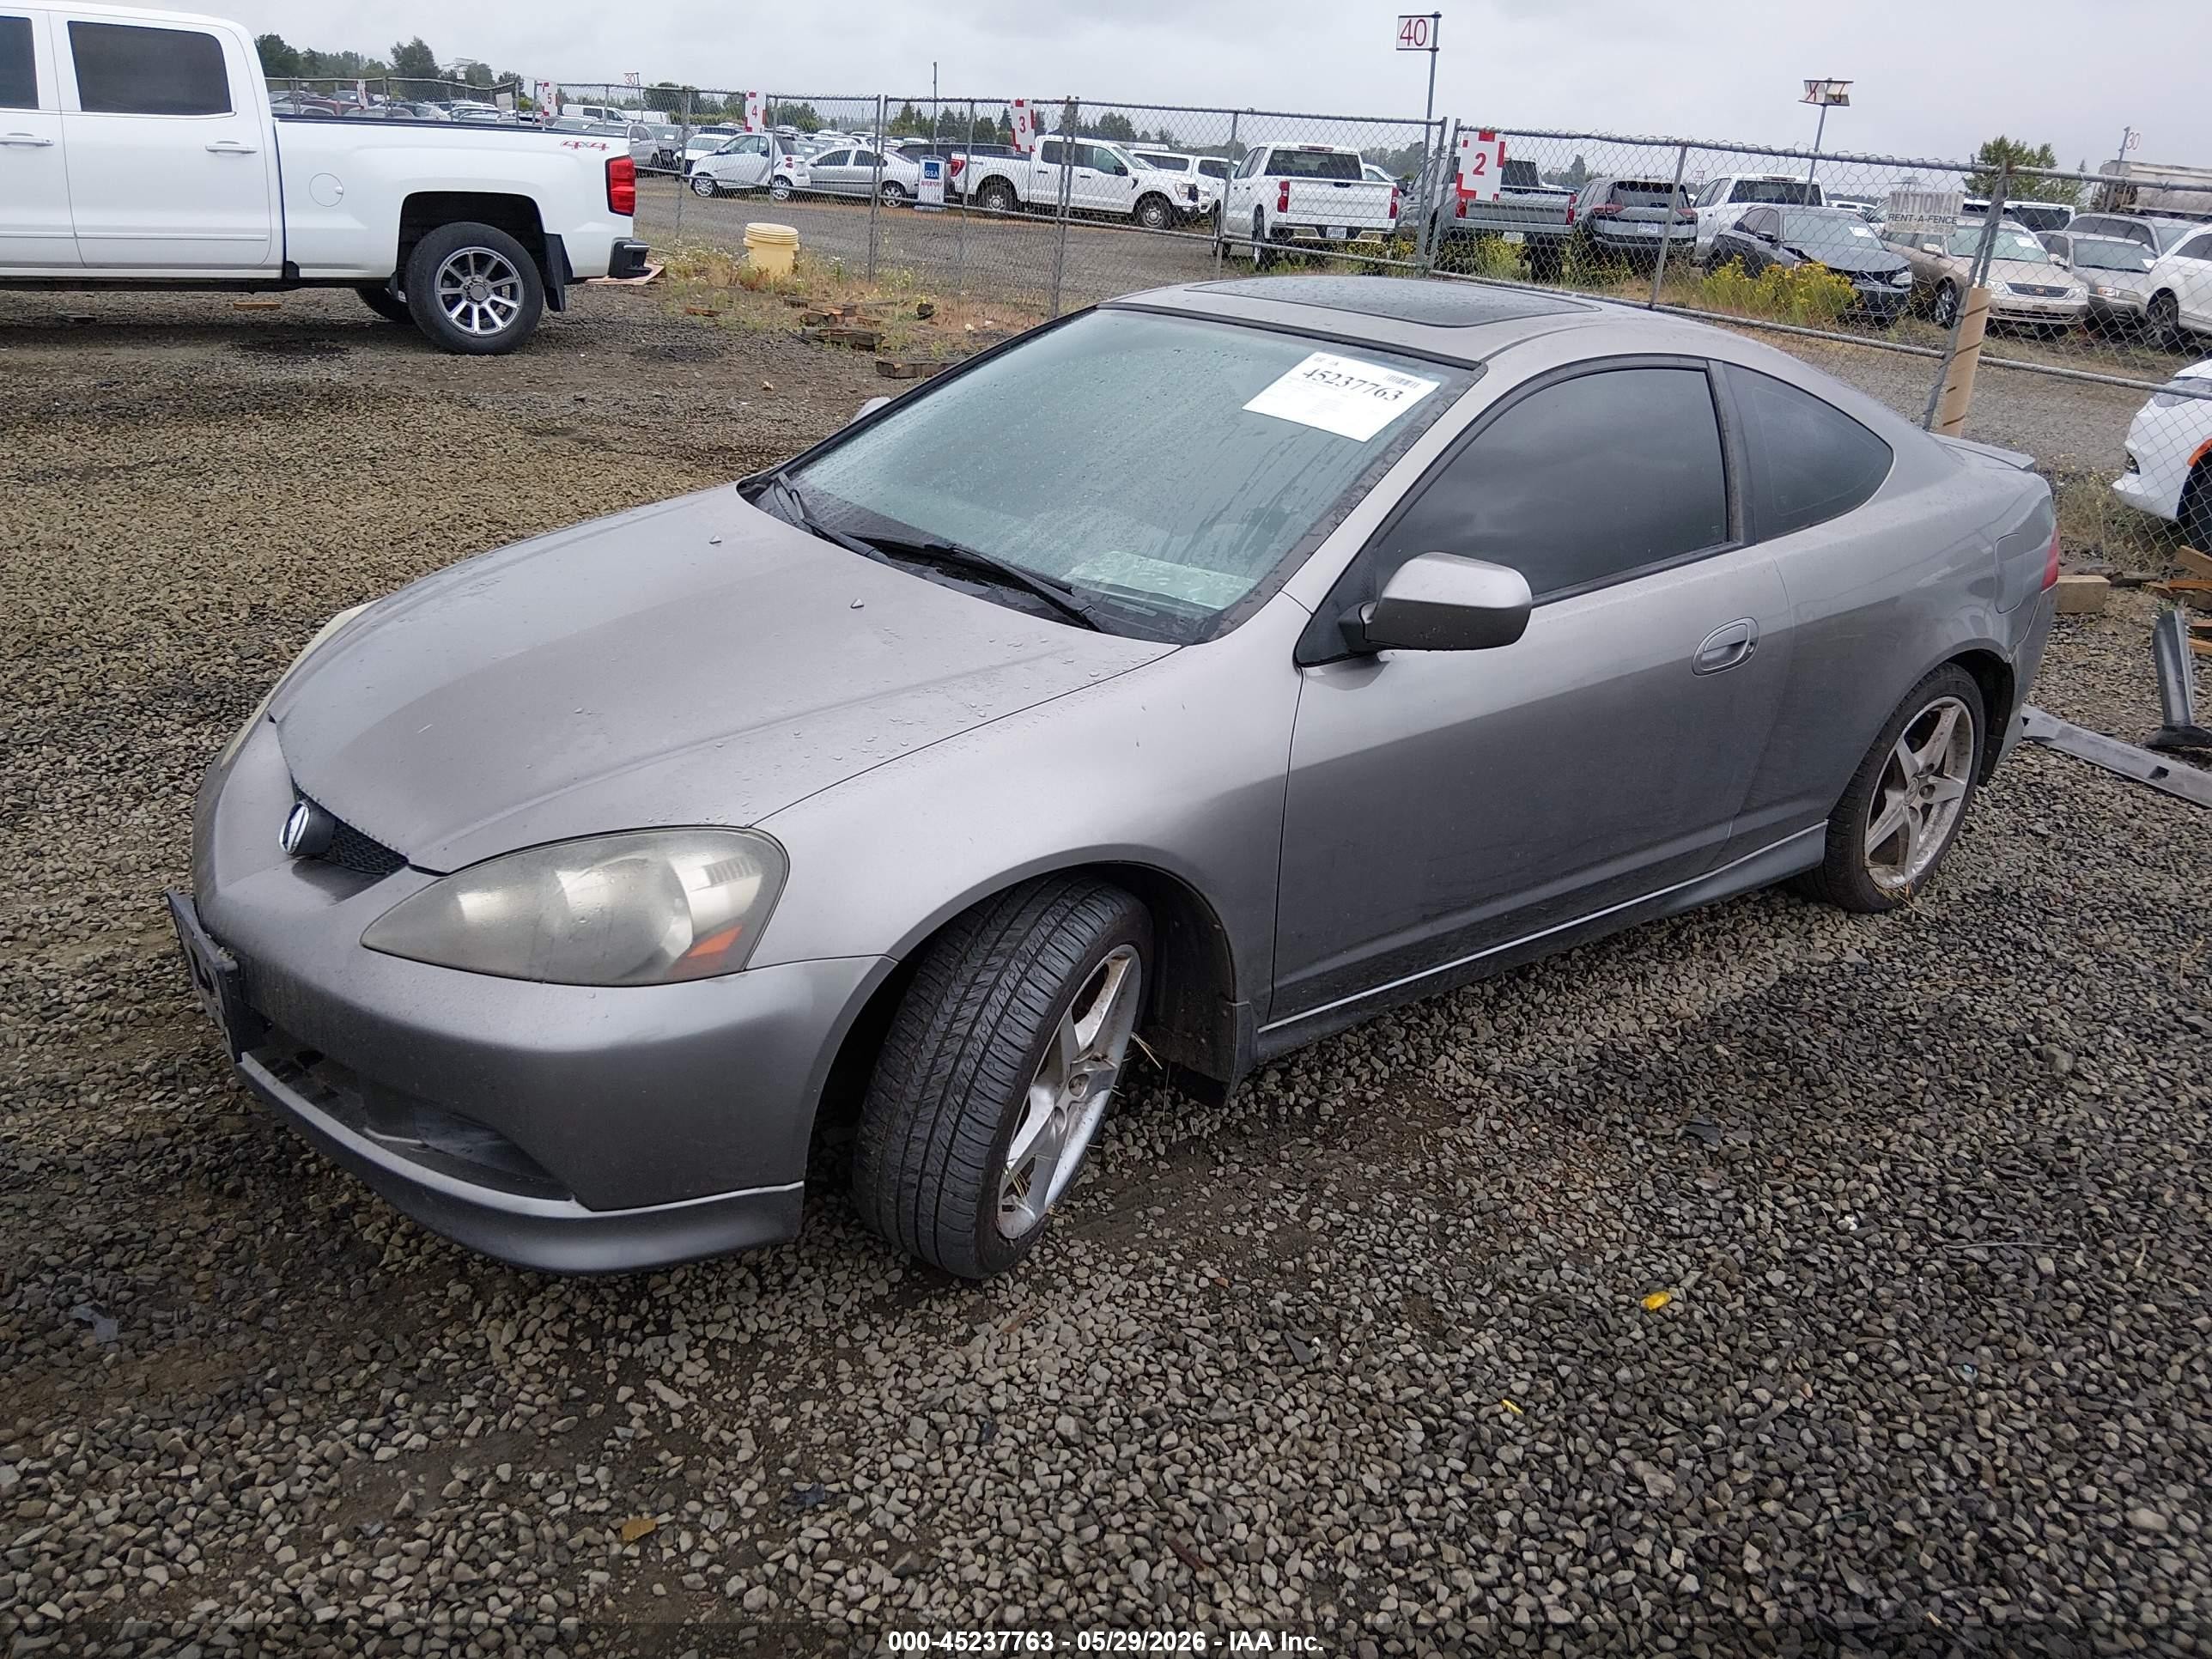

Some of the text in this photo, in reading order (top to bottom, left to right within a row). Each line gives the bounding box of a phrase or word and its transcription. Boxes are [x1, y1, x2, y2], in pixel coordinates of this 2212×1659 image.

[1399, 18, 1427, 46] 40
[624, 74, 636, 85] 30
[547, 93, 552, 104] 5
[751, 104, 757, 118] 4
[1018, 115, 1026, 133] 3
[2125, 131, 2141, 150] 30
[1472, 152, 1486, 176] 2
[1889, 192, 1960, 216] NATIONAL
[1887, 213, 1959, 224] RENT-A-FENCE
[1302, 368, 1404, 402] 45237763
